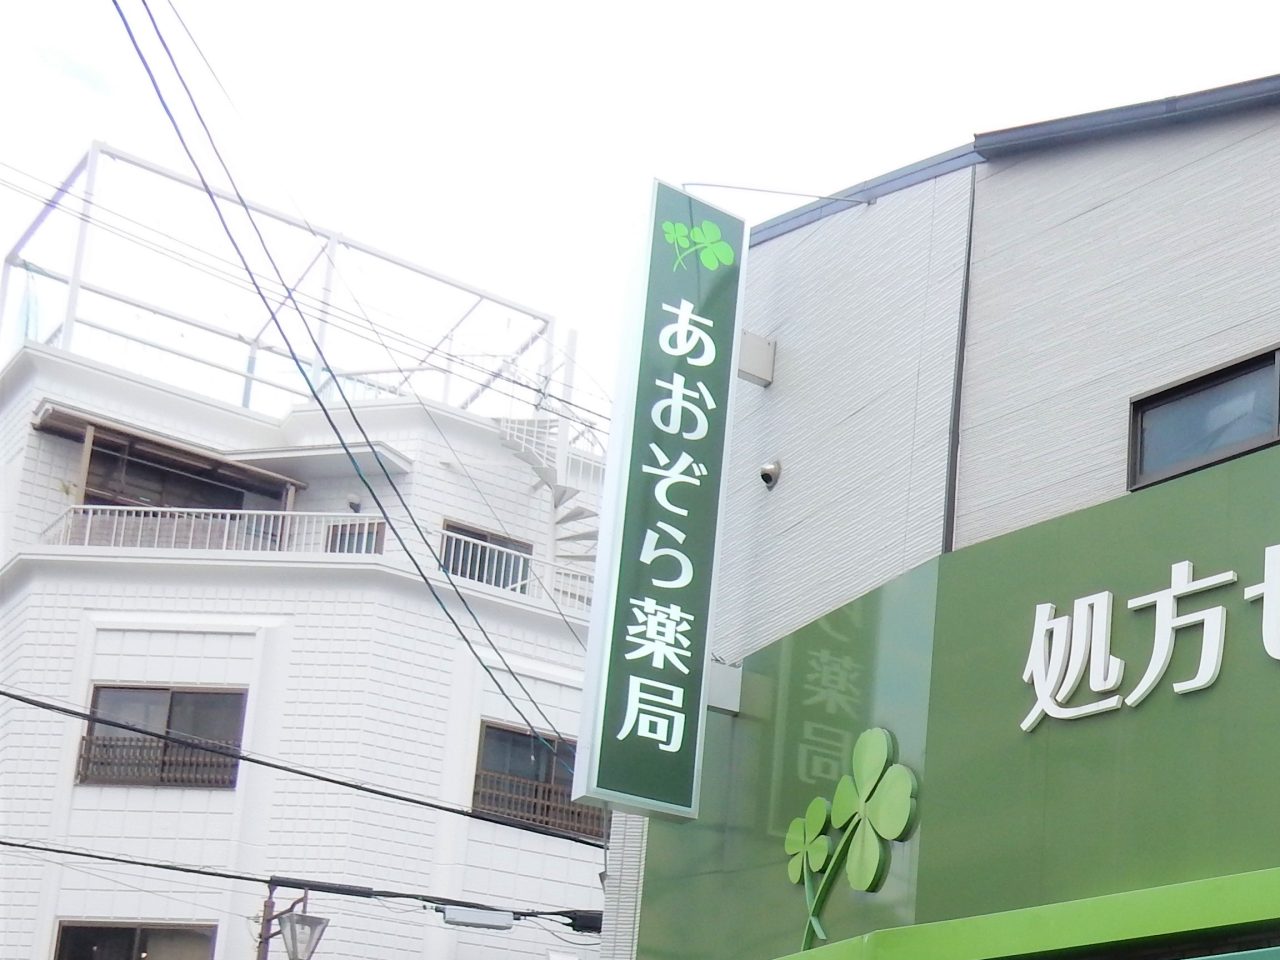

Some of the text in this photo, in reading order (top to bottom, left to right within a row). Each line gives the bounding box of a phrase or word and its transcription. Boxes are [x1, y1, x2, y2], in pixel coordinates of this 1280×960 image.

[616, 298, 716, 752] あおぞら薬局
